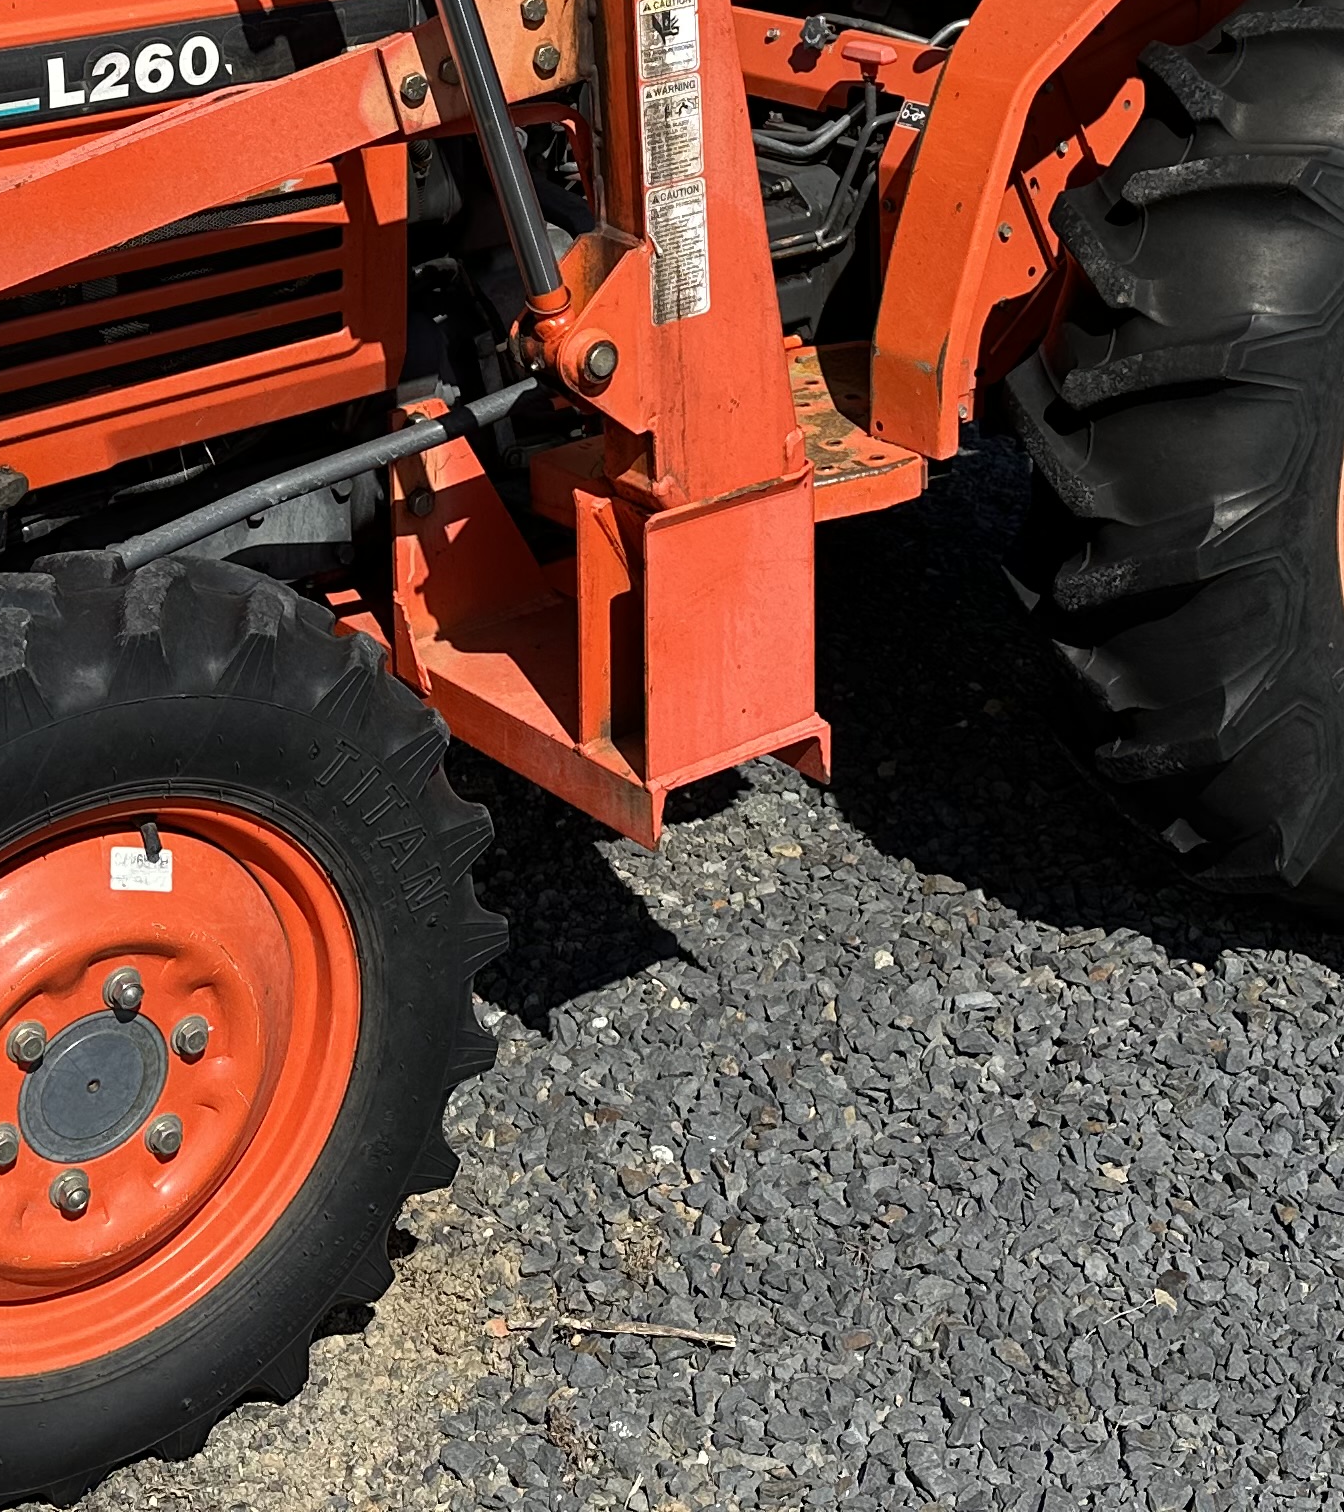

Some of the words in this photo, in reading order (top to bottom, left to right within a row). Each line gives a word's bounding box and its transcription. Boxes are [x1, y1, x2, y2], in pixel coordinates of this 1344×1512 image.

[653, 79, 696, 97] WARNING
[660, 184, 700, 202] CAUTION
[316, 738, 451, 916] TITAN
